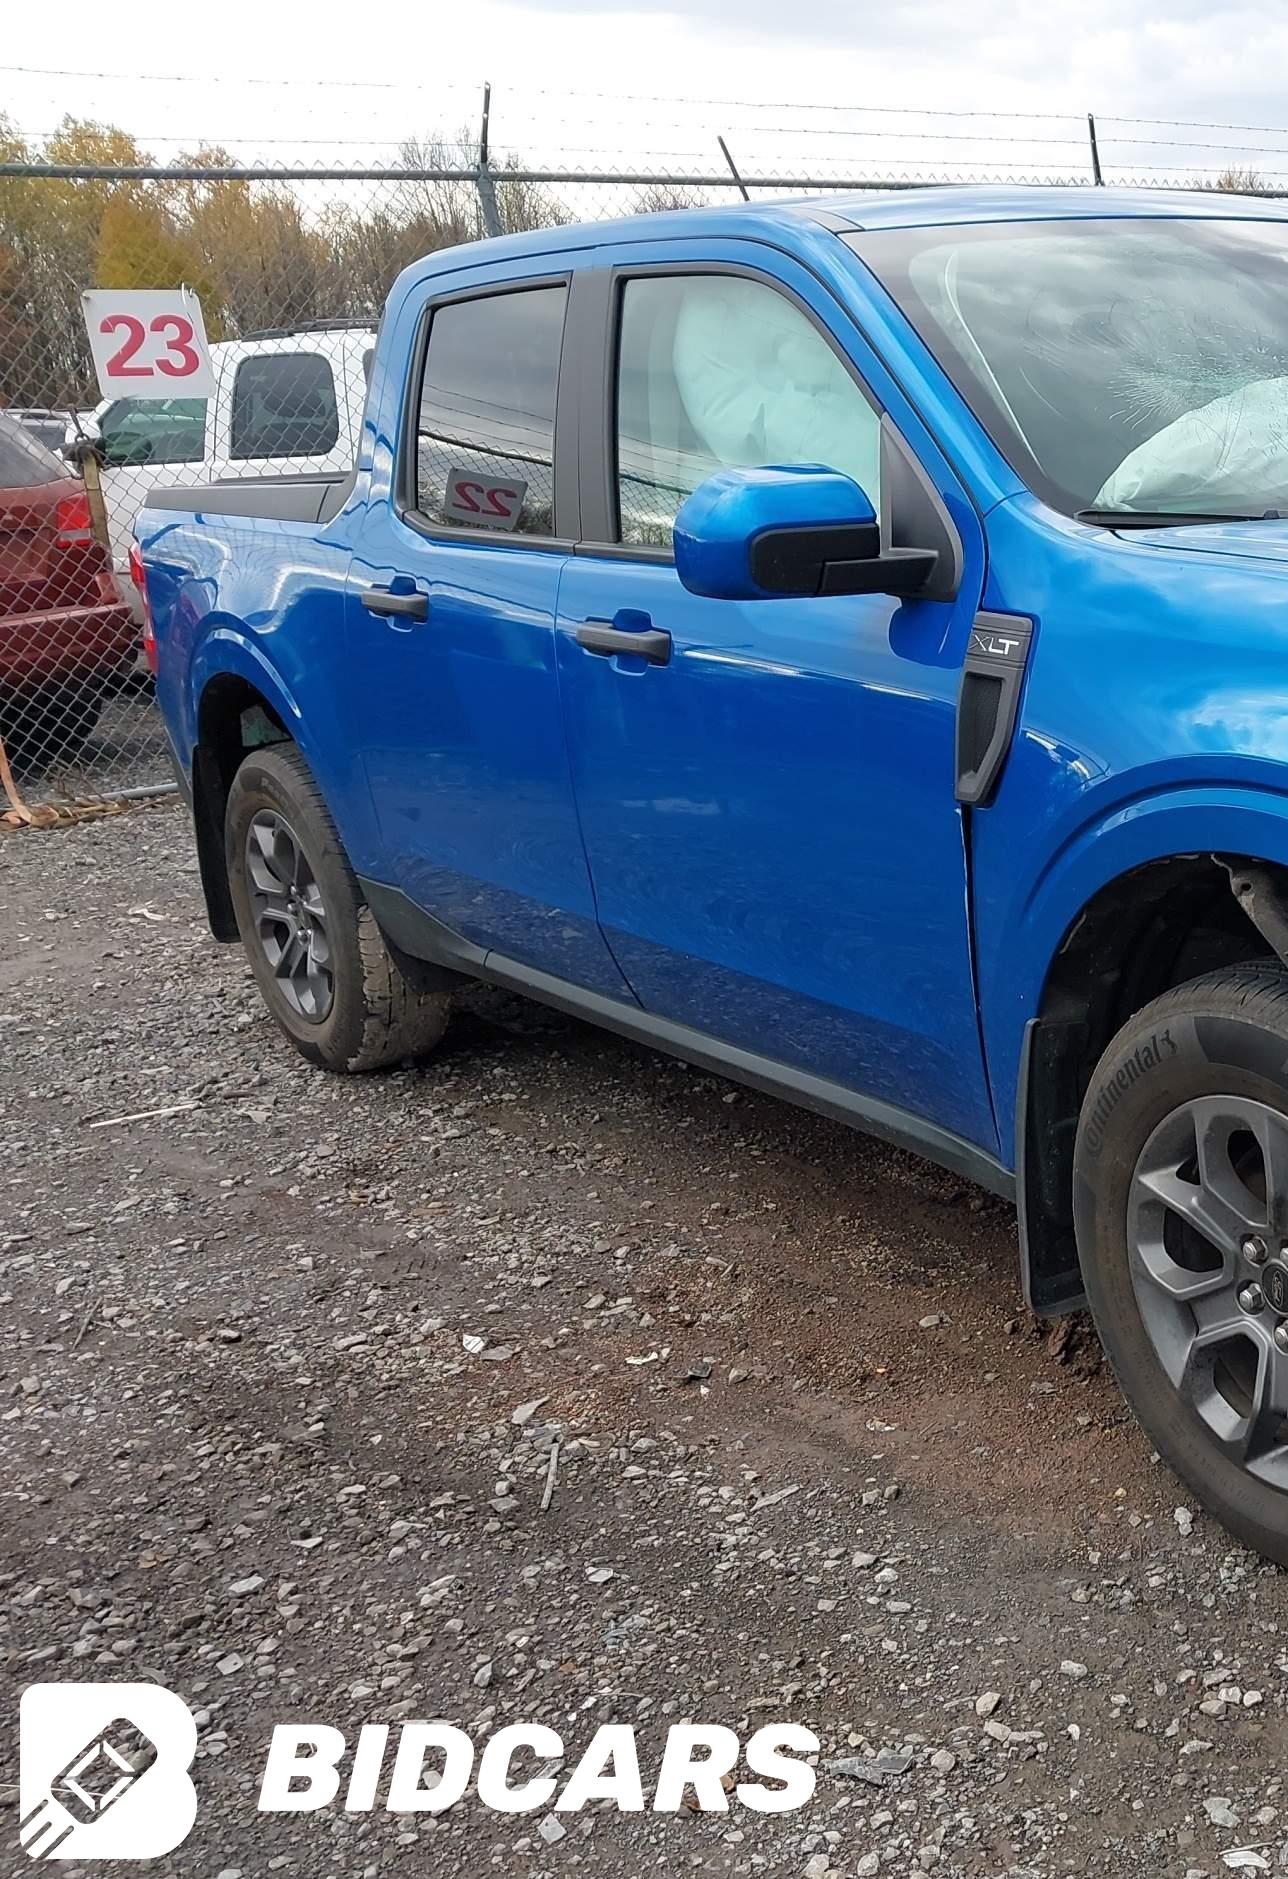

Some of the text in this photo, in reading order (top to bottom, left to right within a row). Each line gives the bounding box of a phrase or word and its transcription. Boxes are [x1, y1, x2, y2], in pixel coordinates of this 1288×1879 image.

[100, 314, 199, 377] 23
[969, 633, 1019, 655] XLT
[1083, 1033, 1162, 1156] Continental
